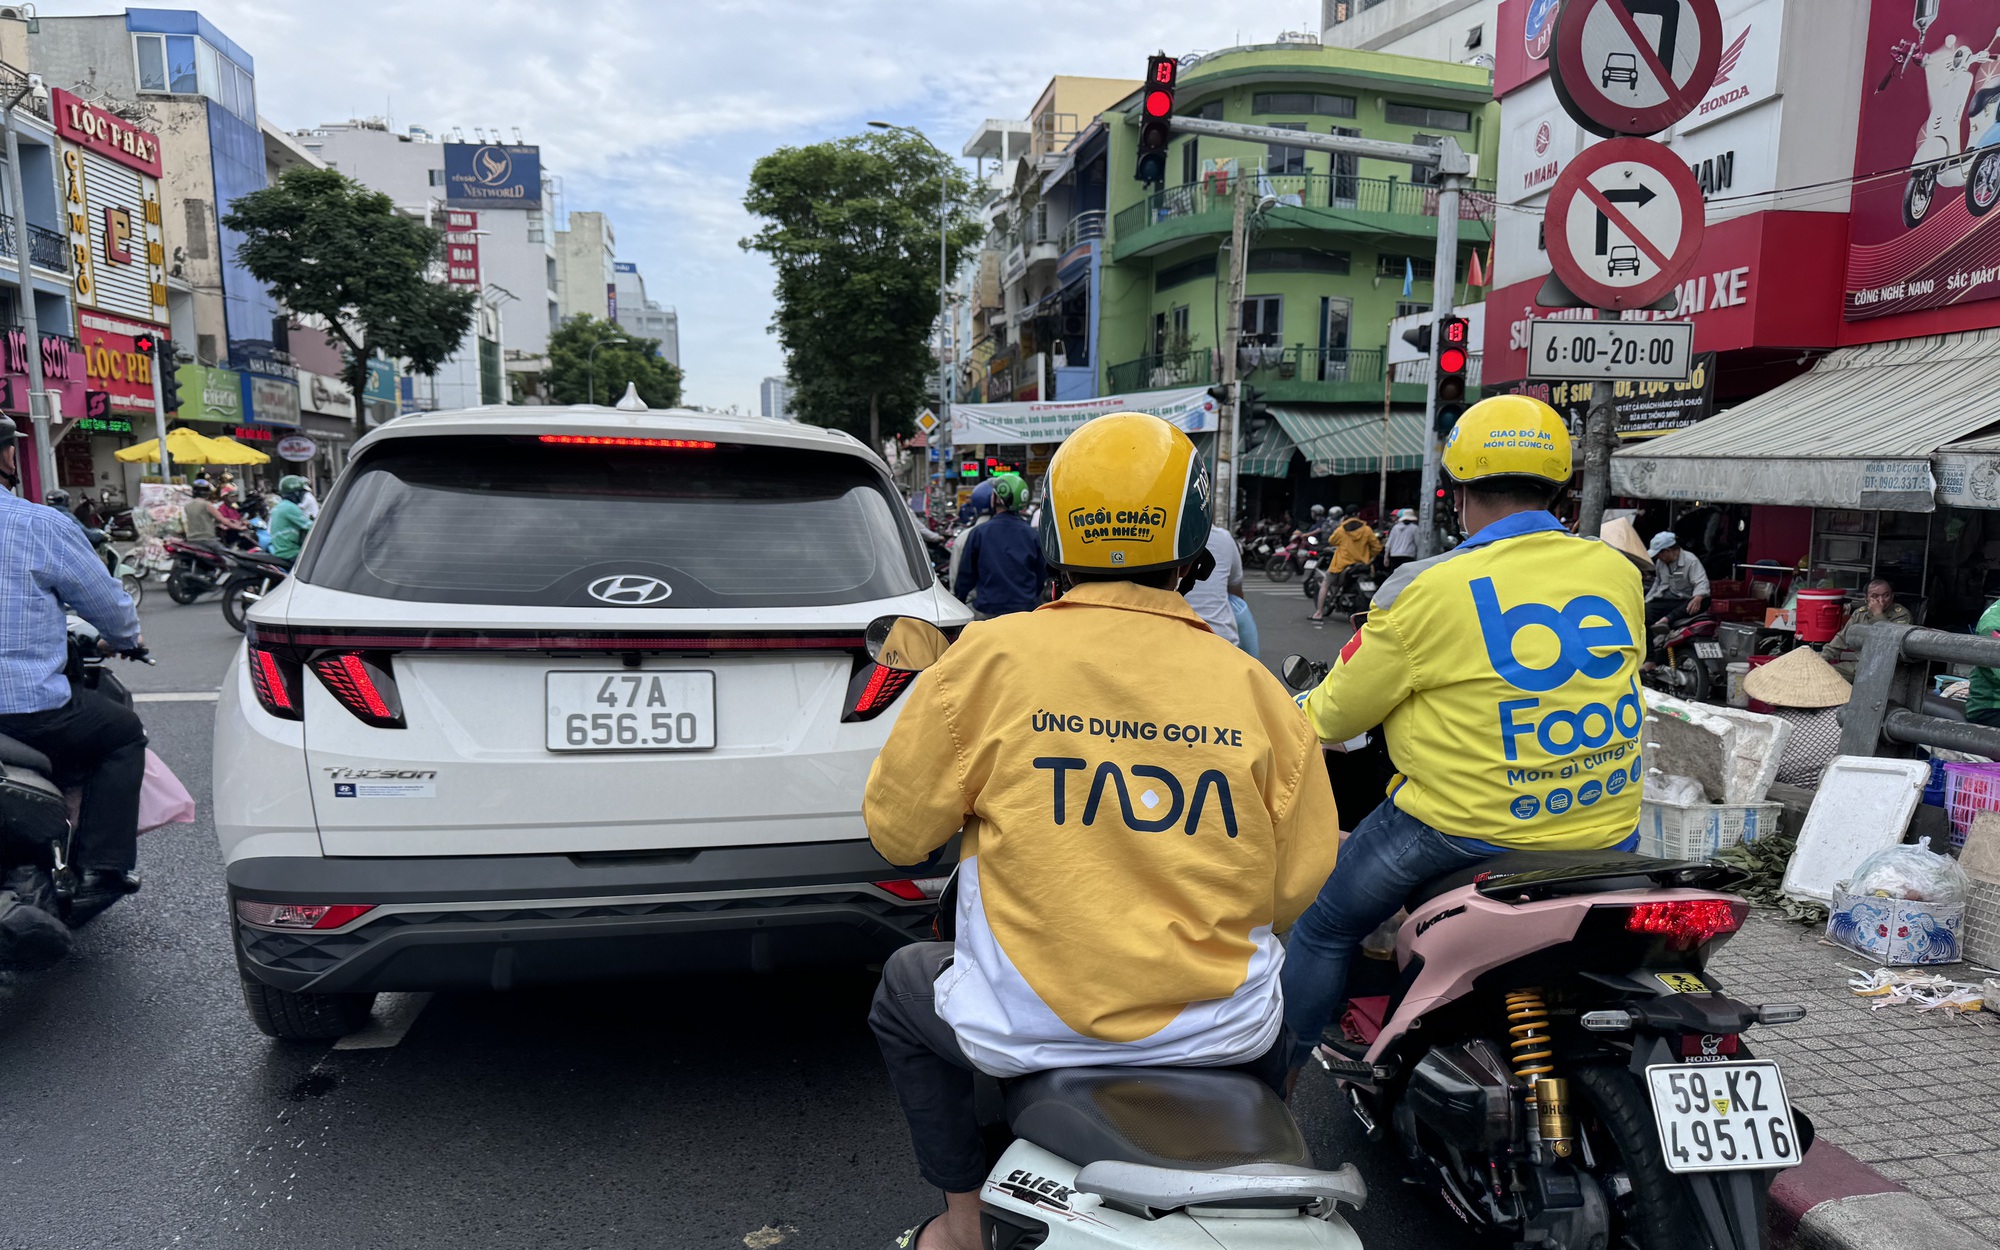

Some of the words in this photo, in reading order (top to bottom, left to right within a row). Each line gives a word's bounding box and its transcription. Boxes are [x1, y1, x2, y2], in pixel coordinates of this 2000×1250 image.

[1699, 85, 1750, 116] HONDA
[71, 101, 107, 143] LỘC
[1524, 161, 1558, 190] YAMAHA
[1709, 266, 1750, 311] XE
[1854, 288, 1879, 305] CÔNG
[1880, 281, 1905, 301] NGHỆ
[1907, 279, 1935, 296] NANO
[1946, 268, 1969, 290] SẮC
[83, 337, 122, 387] LỘC
[125, 352, 153, 385] PH
[1546, 336, 1674, 365] 6:00-20:00
[1570, 382, 1595, 402] SIN
[1483, 440, 1504, 448] MÓN
[1507, 439, 1516, 448] GÌ
[1518, 439, 1542, 449] CŨNG
[1543, 443, 1554, 451] CÓ
[1489, 429, 1516, 438] GIAO
[1519, 428, 1535, 438] ĐỒ
[1537, 430, 1551, 440] ĂN
[1073, 506, 1112, 528] NGỒI
[1115, 505, 1162, 526] CHẮC
[1084, 527, 1109, 539] BẠN
[1111, 525, 1151, 537] NHÉ!!!
[1469, 576, 1634, 692] be
[596, 676, 667, 708] 47A
[566, 712, 697, 746] 656.50
[1032, 709, 1084, 733] ỨNG
[1089, 717, 1158, 744] DỤNG
[1163, 723, 1207, 749] GỌI
[1213, 726, 1243, 748] XE
[1498, 675, 1643, 762] Food
[323, 766, 438, 780] Tucson
[1560, 758, 1579, 779] gì
[1032, 756, 1239, 839] TADA
[1684, 1055, 1730, 1063] HONDA
[1668, 1070, 1768, 1114] 59-K2
[1671, 1116, 1791, 1163] 495.16
[1007, 1169, 1078, 1203] CLICK
